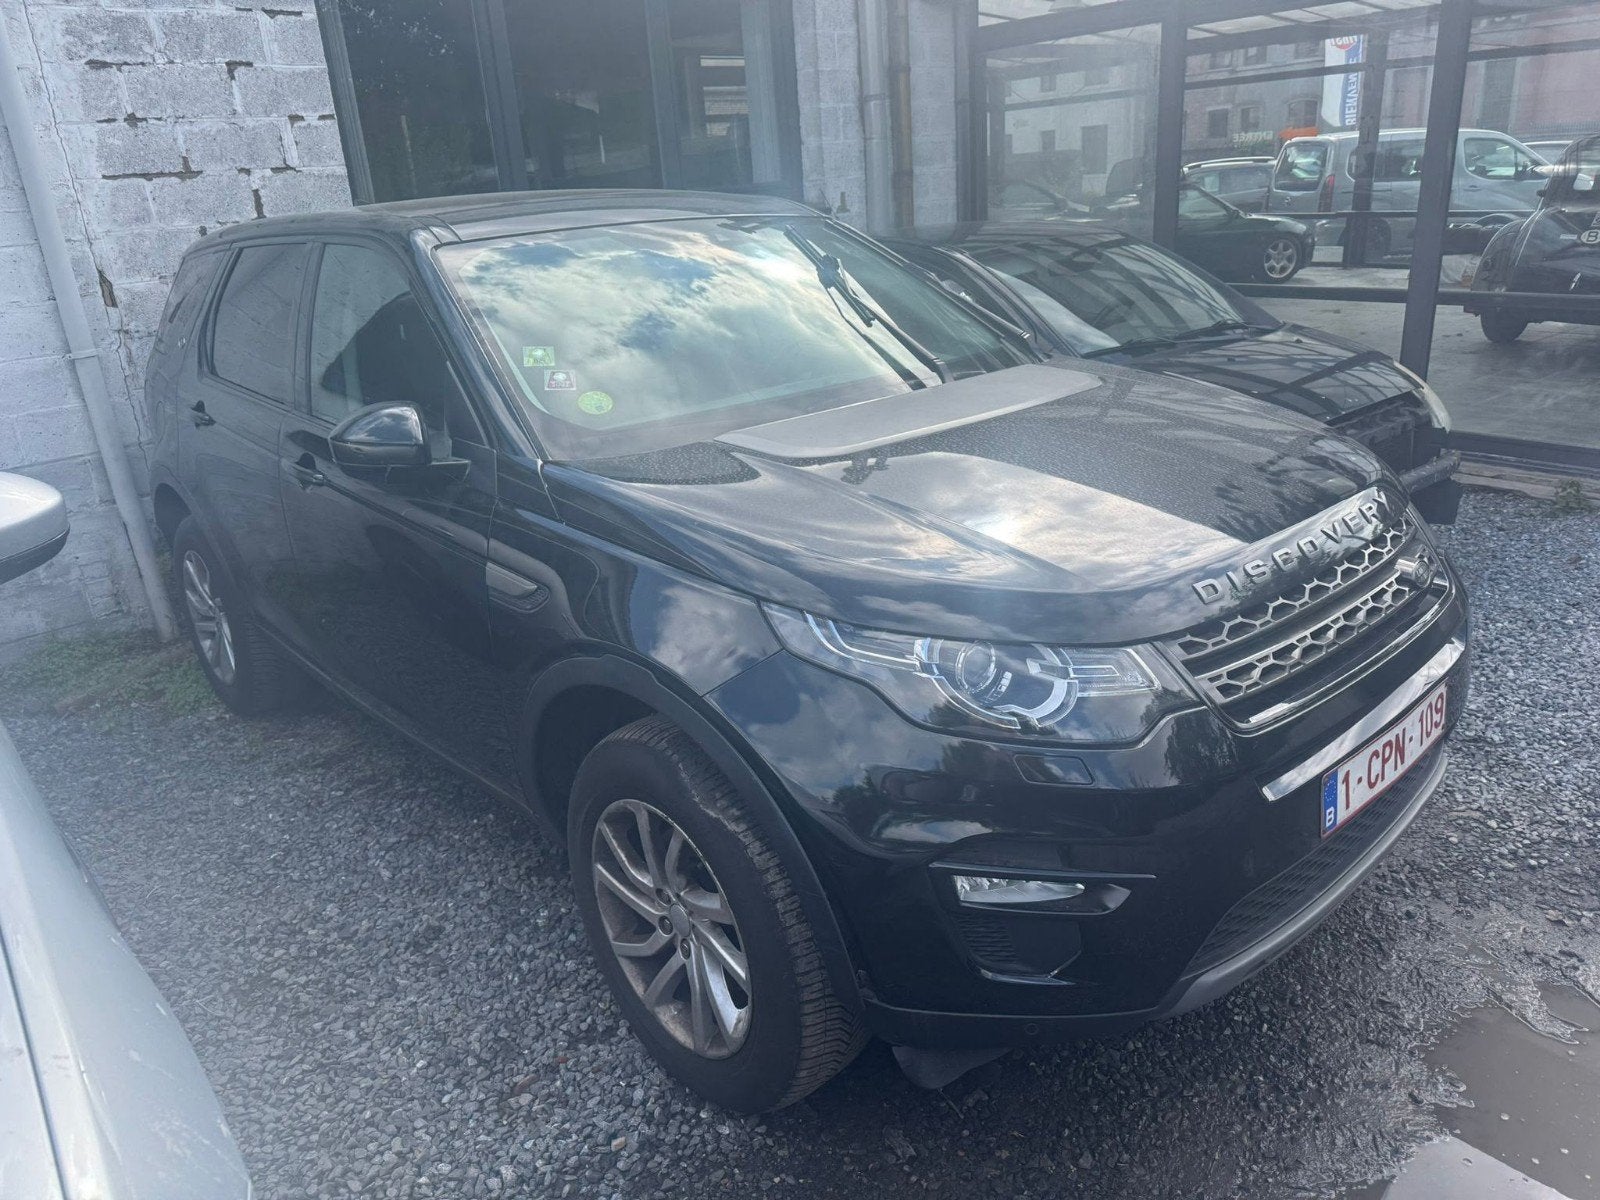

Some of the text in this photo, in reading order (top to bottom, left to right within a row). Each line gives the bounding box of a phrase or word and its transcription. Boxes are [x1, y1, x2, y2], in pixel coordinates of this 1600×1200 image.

[1192, 489, 1389, 604] DISCOVERY
[1341, 691, 1445, 811] 1-CPN-109
[1325, 806, 1335, 828] B
